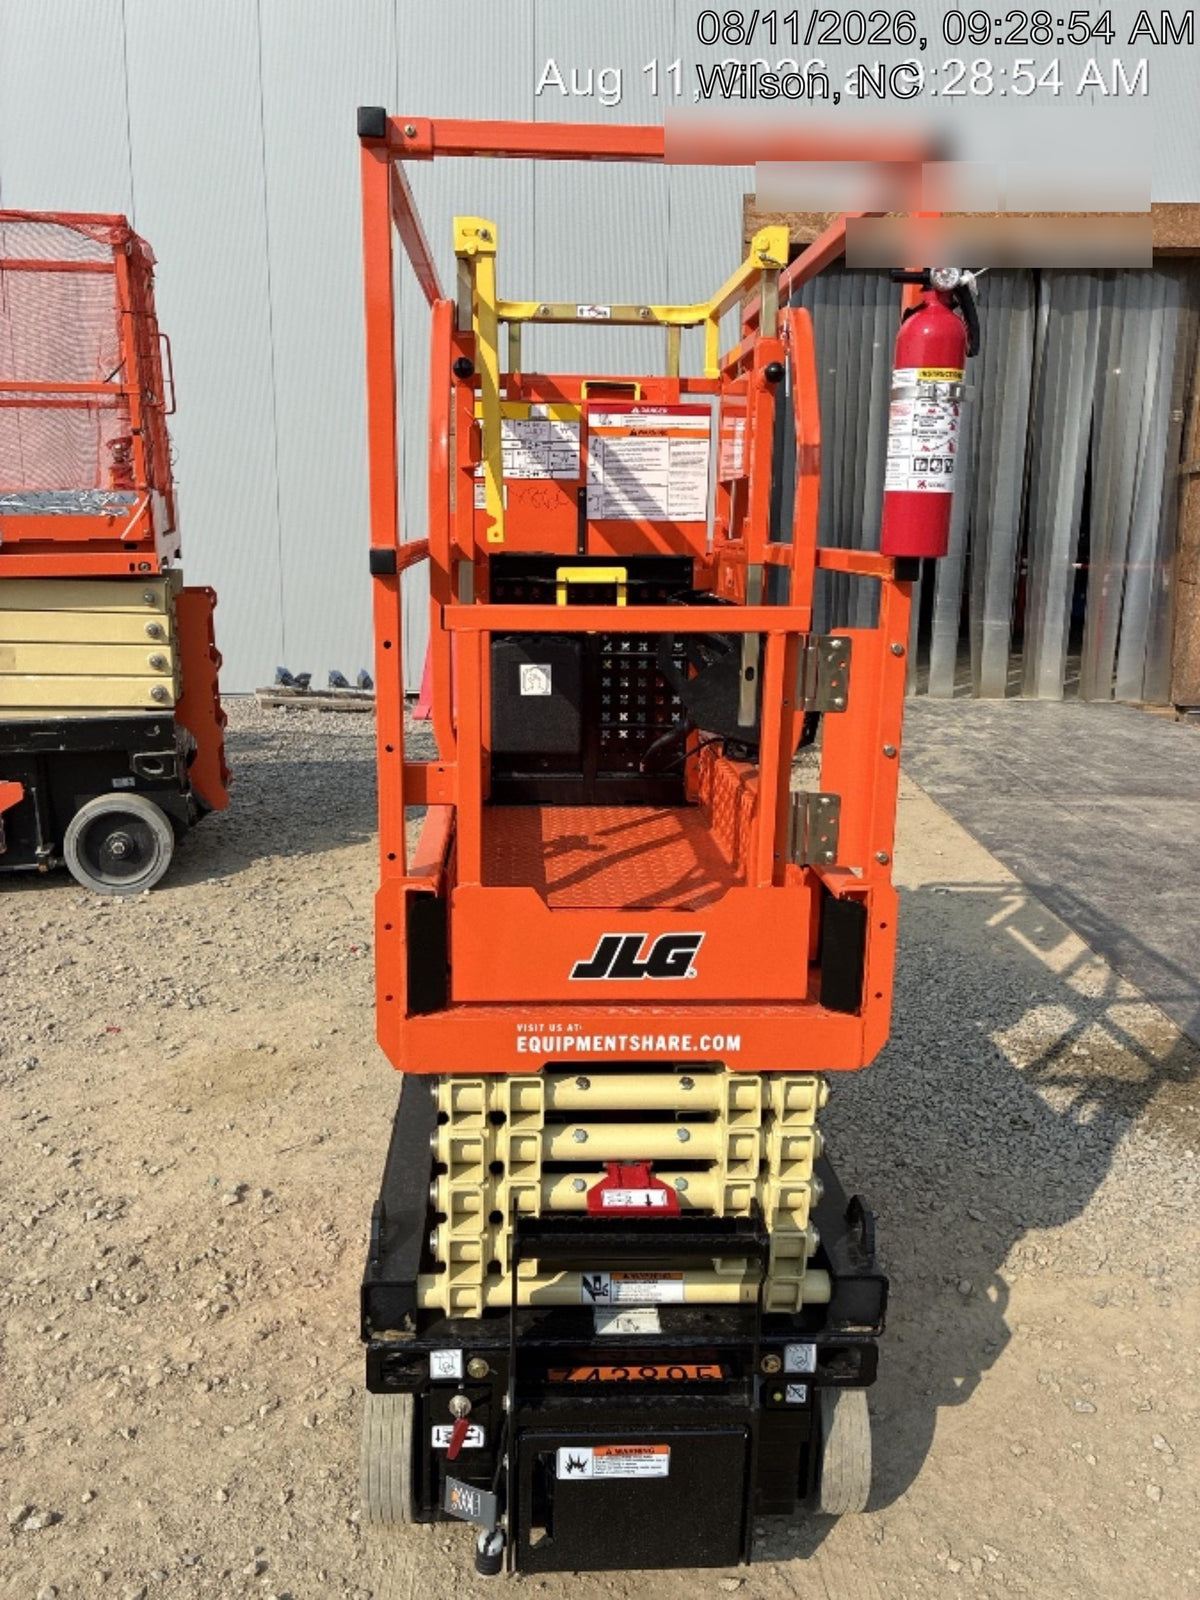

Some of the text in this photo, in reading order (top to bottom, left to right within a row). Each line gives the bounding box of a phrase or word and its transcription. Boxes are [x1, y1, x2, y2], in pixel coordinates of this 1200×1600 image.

[568, 931, 706, 981] JLG
[516, 1023, 582, 1033] VISIT US AT:
[516, 1035, 742, 1054] EQUIPMENTSHARE.COM
